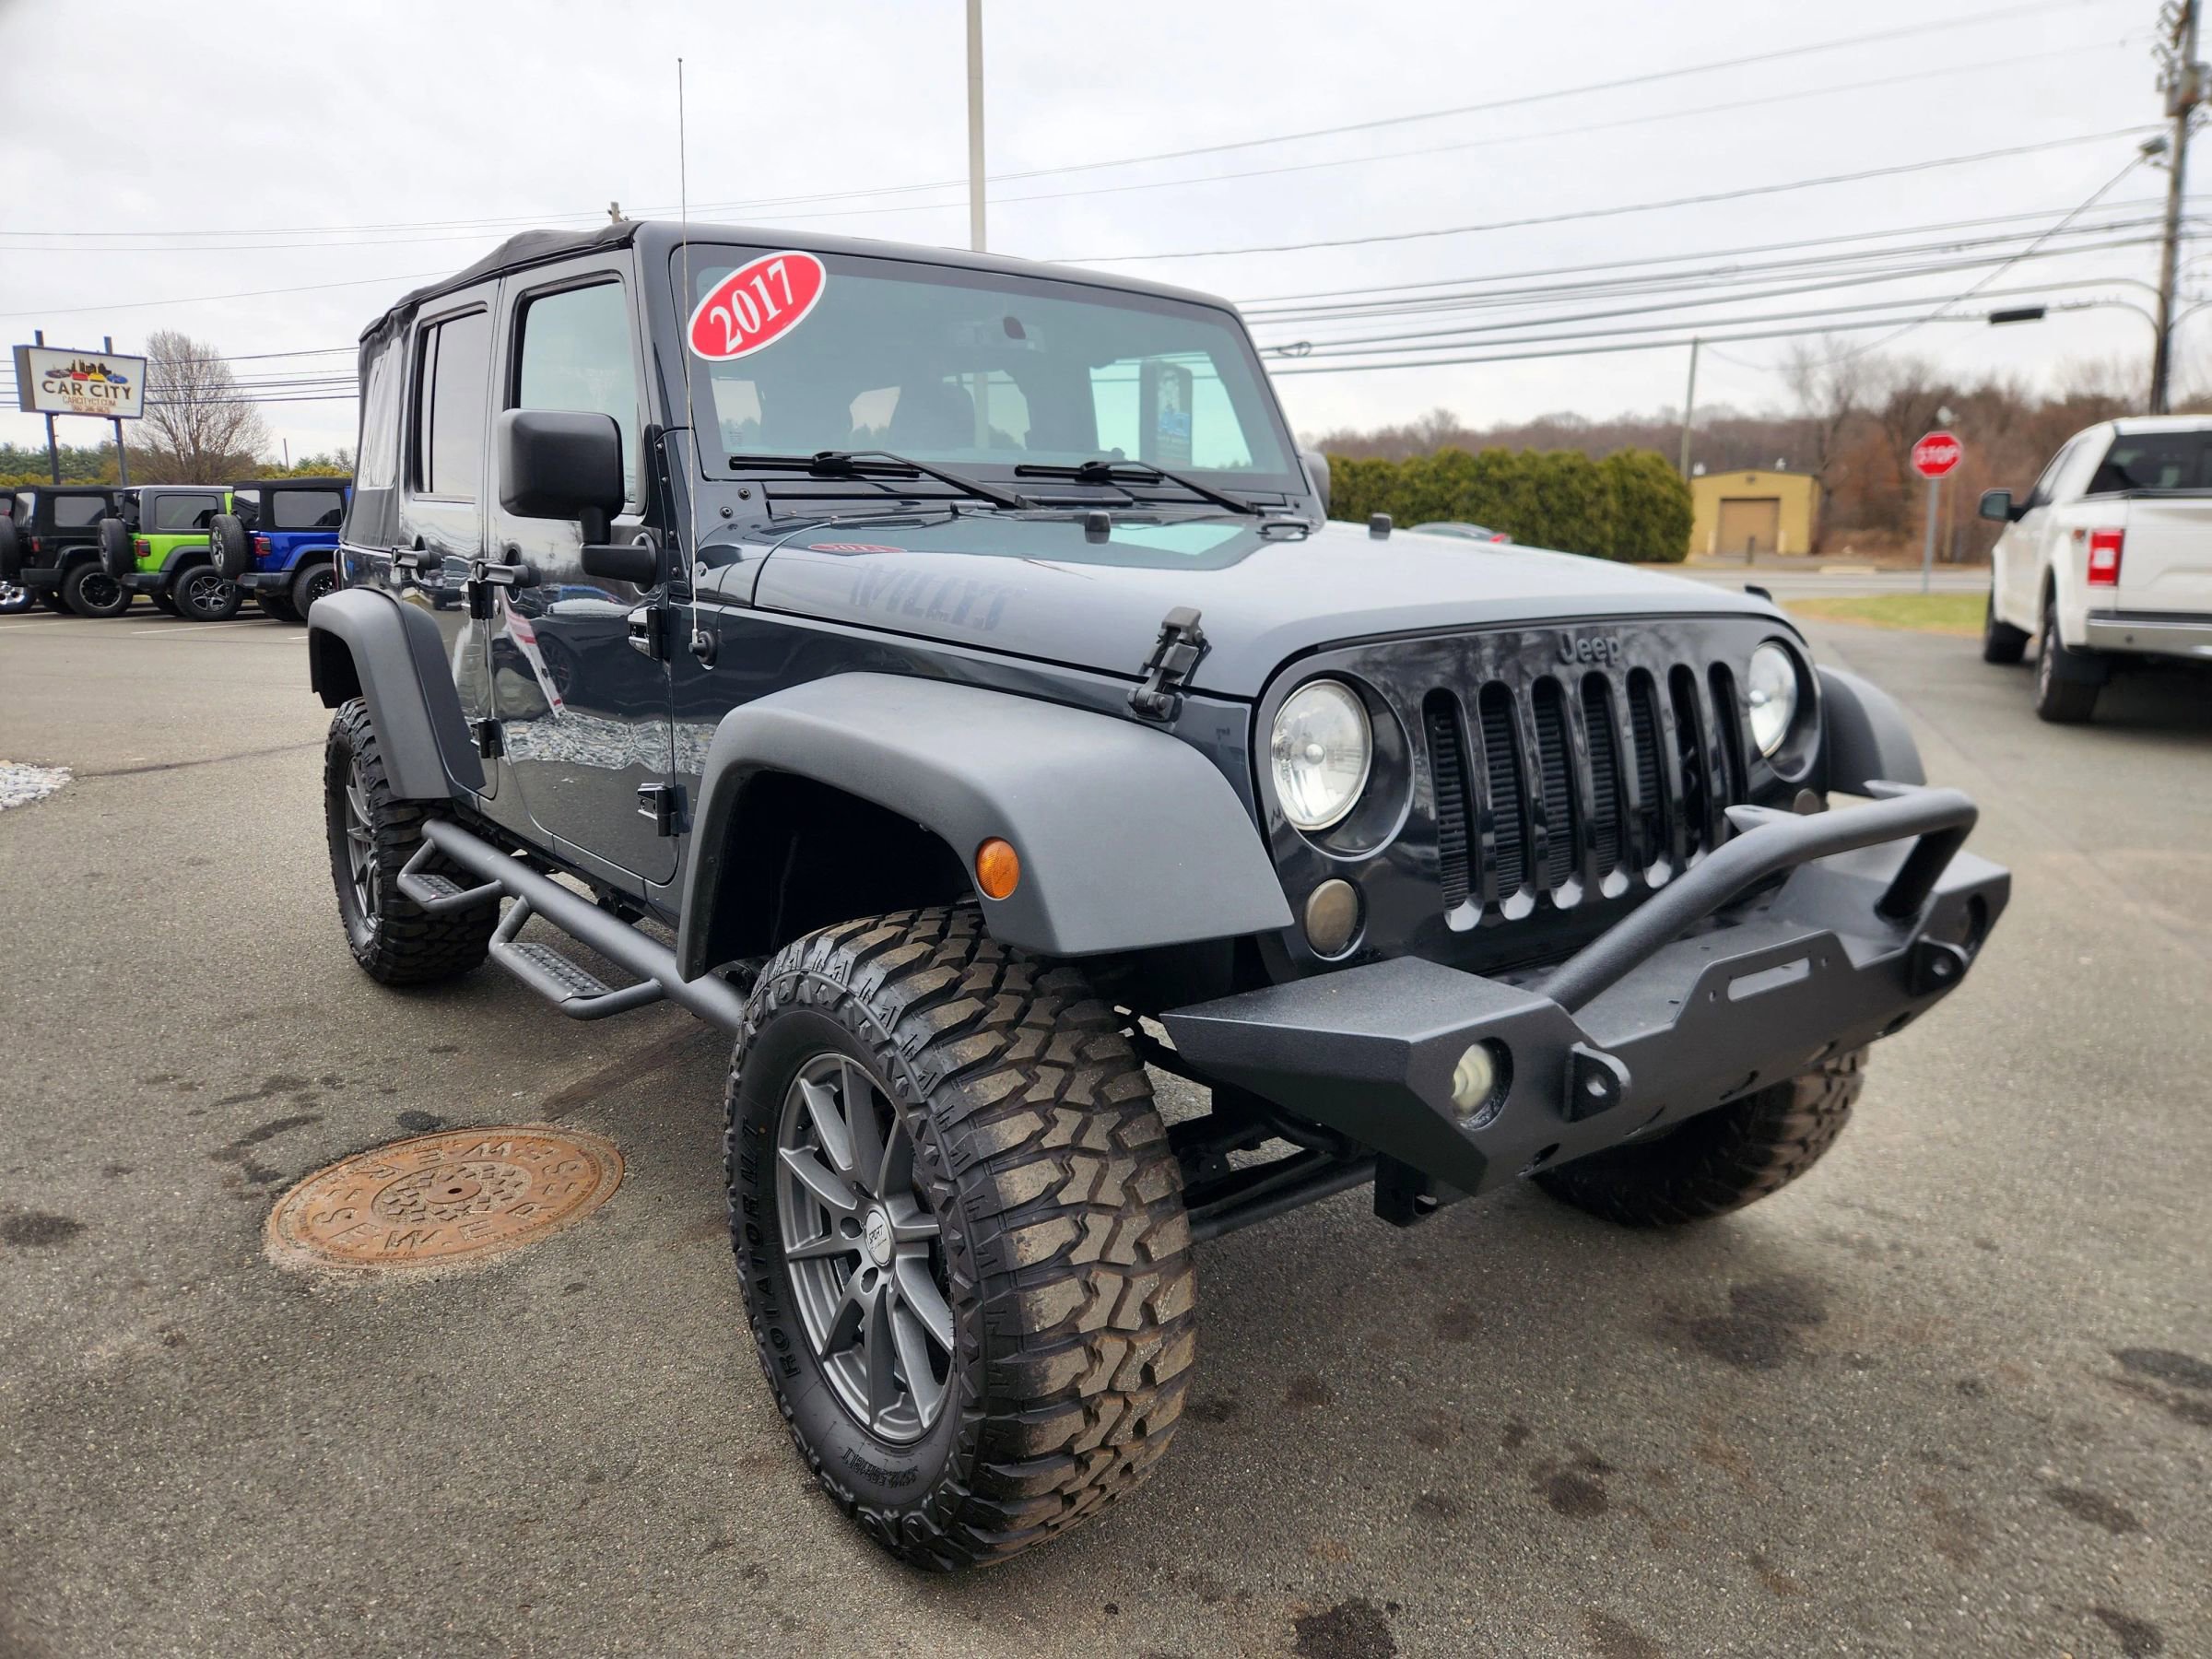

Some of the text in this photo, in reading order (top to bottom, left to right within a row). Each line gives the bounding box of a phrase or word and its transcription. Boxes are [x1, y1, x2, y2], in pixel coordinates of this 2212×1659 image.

[709, 257, 797, 354] 2017
[41, 380, 132, 400] CAR CITY
[1917, 445, 1960, 465] STOP
[1557, 633, 1623, 667] Jeep
[739, 1116, 802, 1379] ROTATOR M/T
